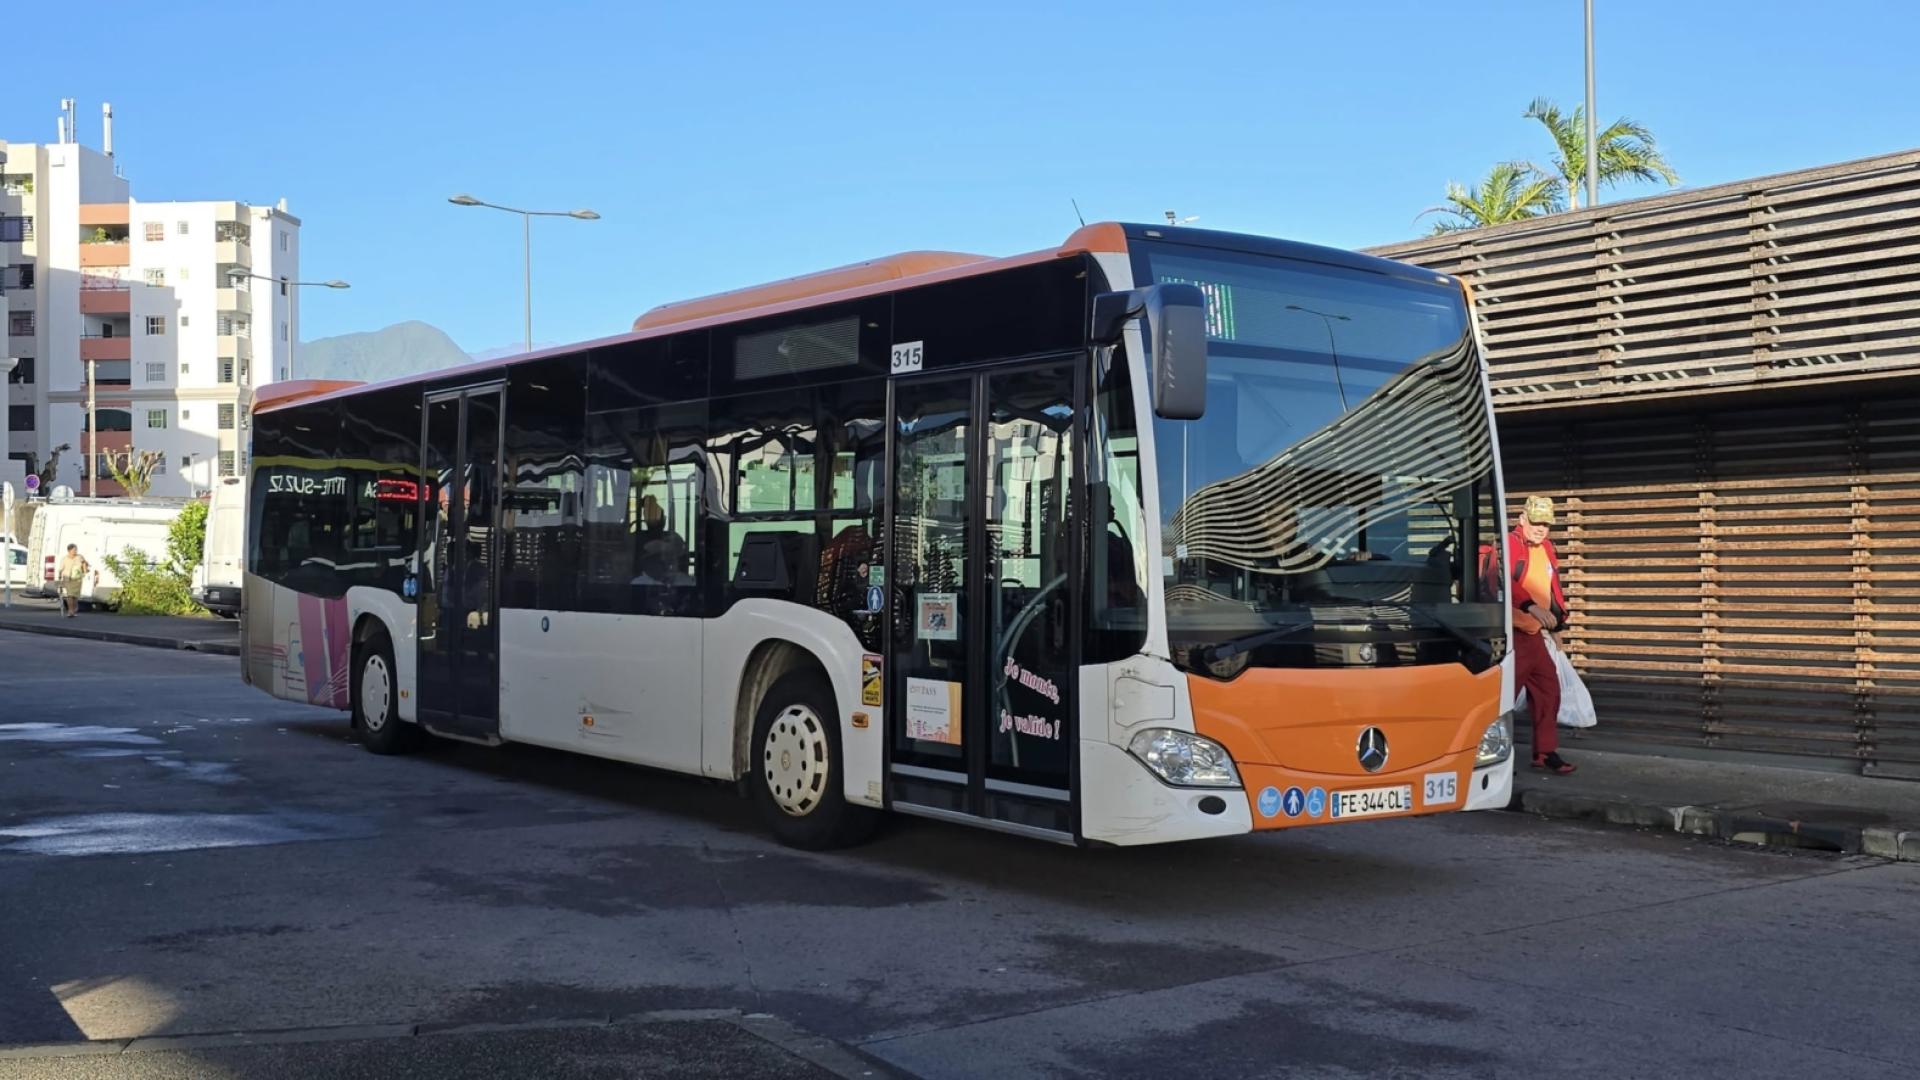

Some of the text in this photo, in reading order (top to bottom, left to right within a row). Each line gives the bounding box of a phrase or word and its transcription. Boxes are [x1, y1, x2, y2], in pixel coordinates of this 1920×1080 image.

[893, 347, 921, 368] 315
[1004, 656, 1019, 680] Je
[1013, 714, 1053, 739] valide
[1426, 779, 1455, 799] 315
[1341, 790, 1402, 814] FE-344-CL
